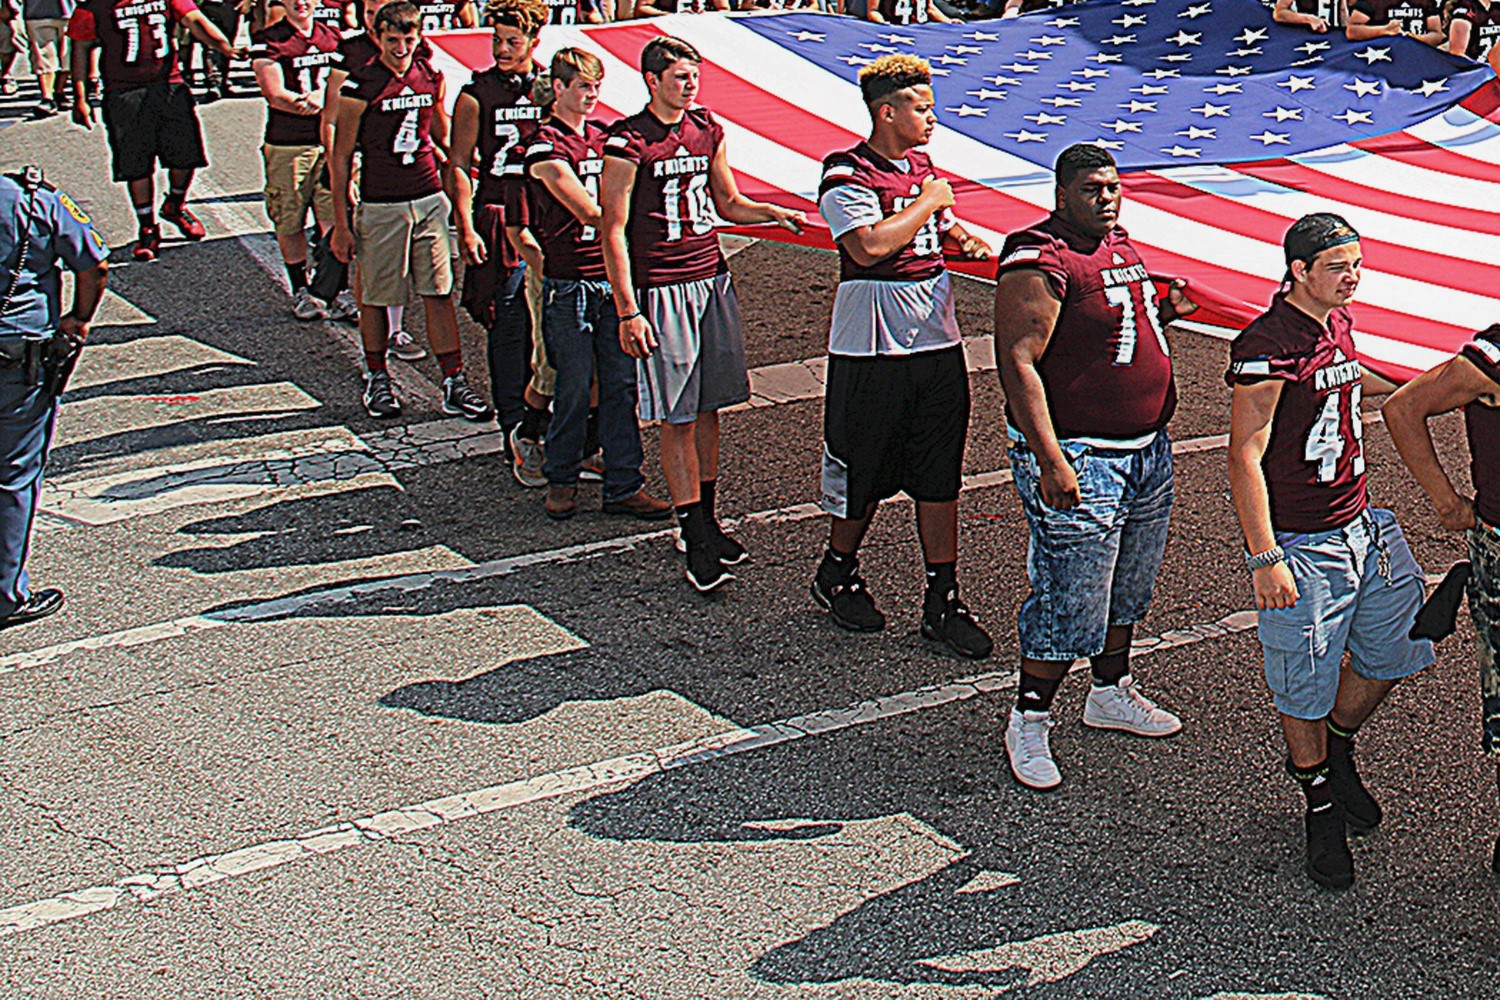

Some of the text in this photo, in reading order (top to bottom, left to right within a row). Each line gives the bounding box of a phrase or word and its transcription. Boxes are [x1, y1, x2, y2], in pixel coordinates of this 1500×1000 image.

[114, 0, 167, 19] KNIGHTS
[117, 13, 169, 63] 73
[381, 93, 434, 112] KNIGHTS
[495, 105, 542, 121] KNIGHT
[489, 123, 528, 177] 2
[653, 155, 709, 178] KNIGHTS
